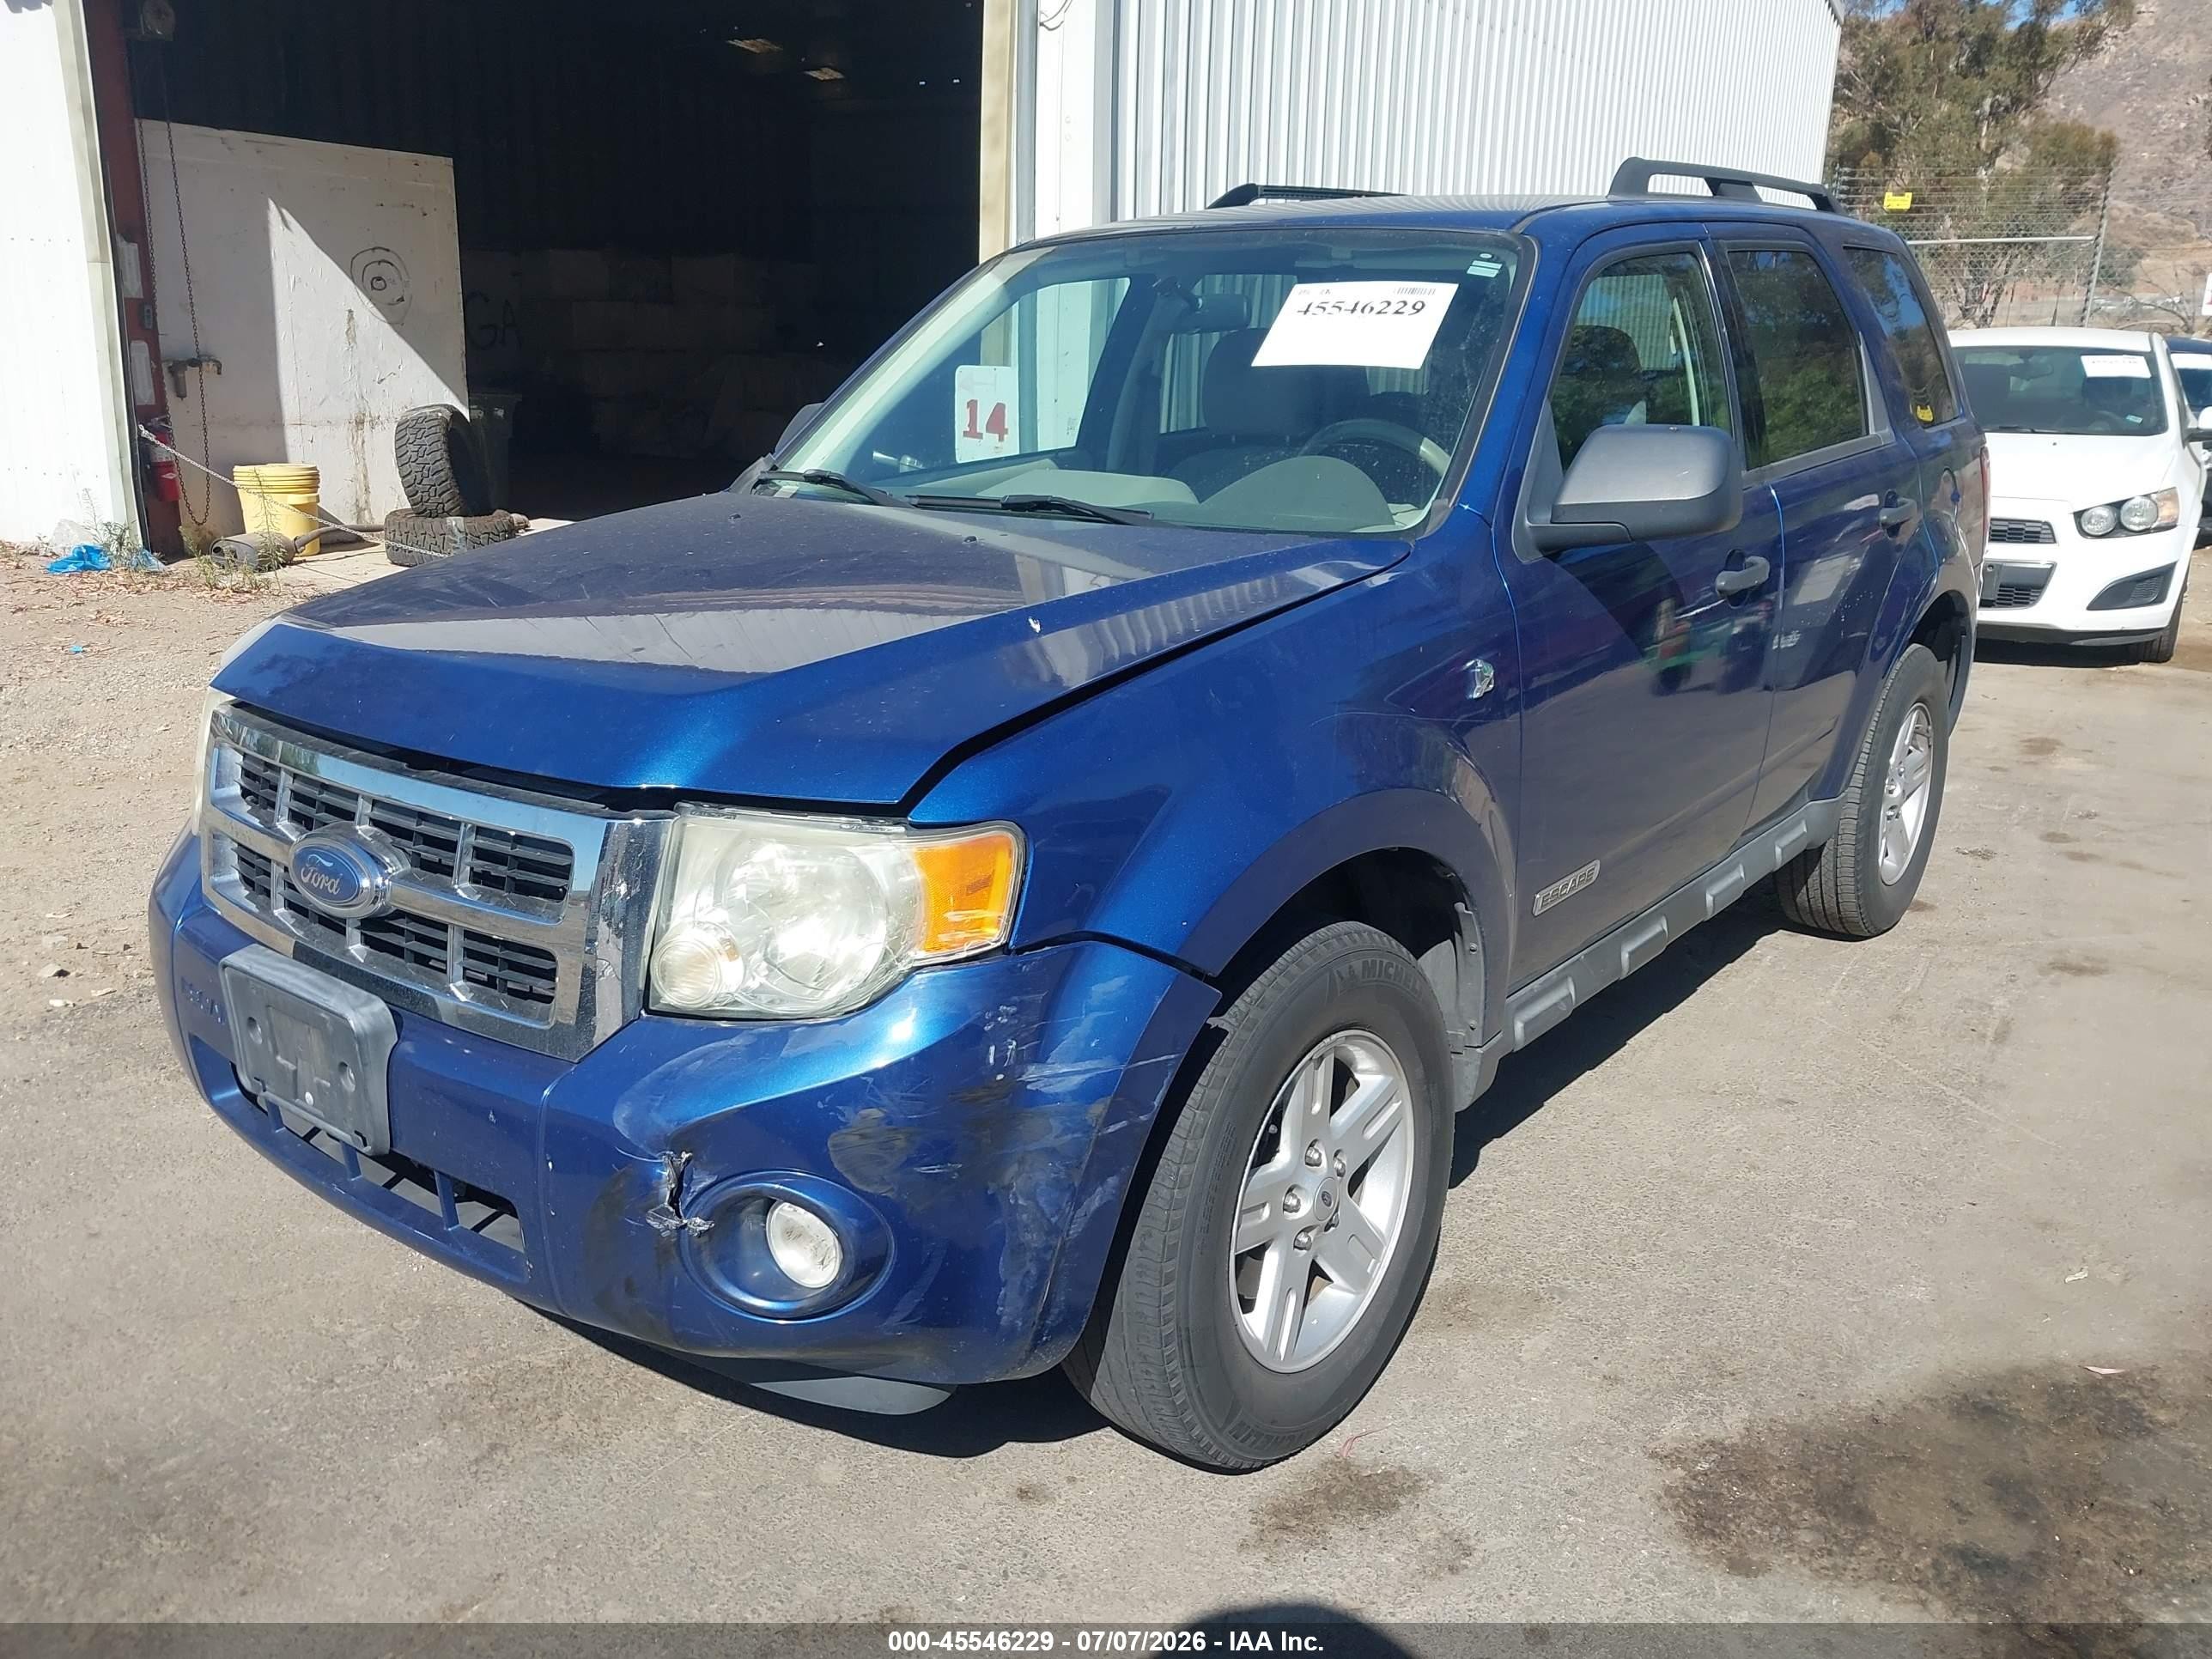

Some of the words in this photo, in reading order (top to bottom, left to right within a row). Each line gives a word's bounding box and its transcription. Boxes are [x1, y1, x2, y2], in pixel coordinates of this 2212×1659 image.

[1297, 300, 1426, 316] 45546229
[963, 399, 1009, 442] 14
[301, 854, 342, 896] Ford
[1540, 865, 1595, 909] ESCAPE
